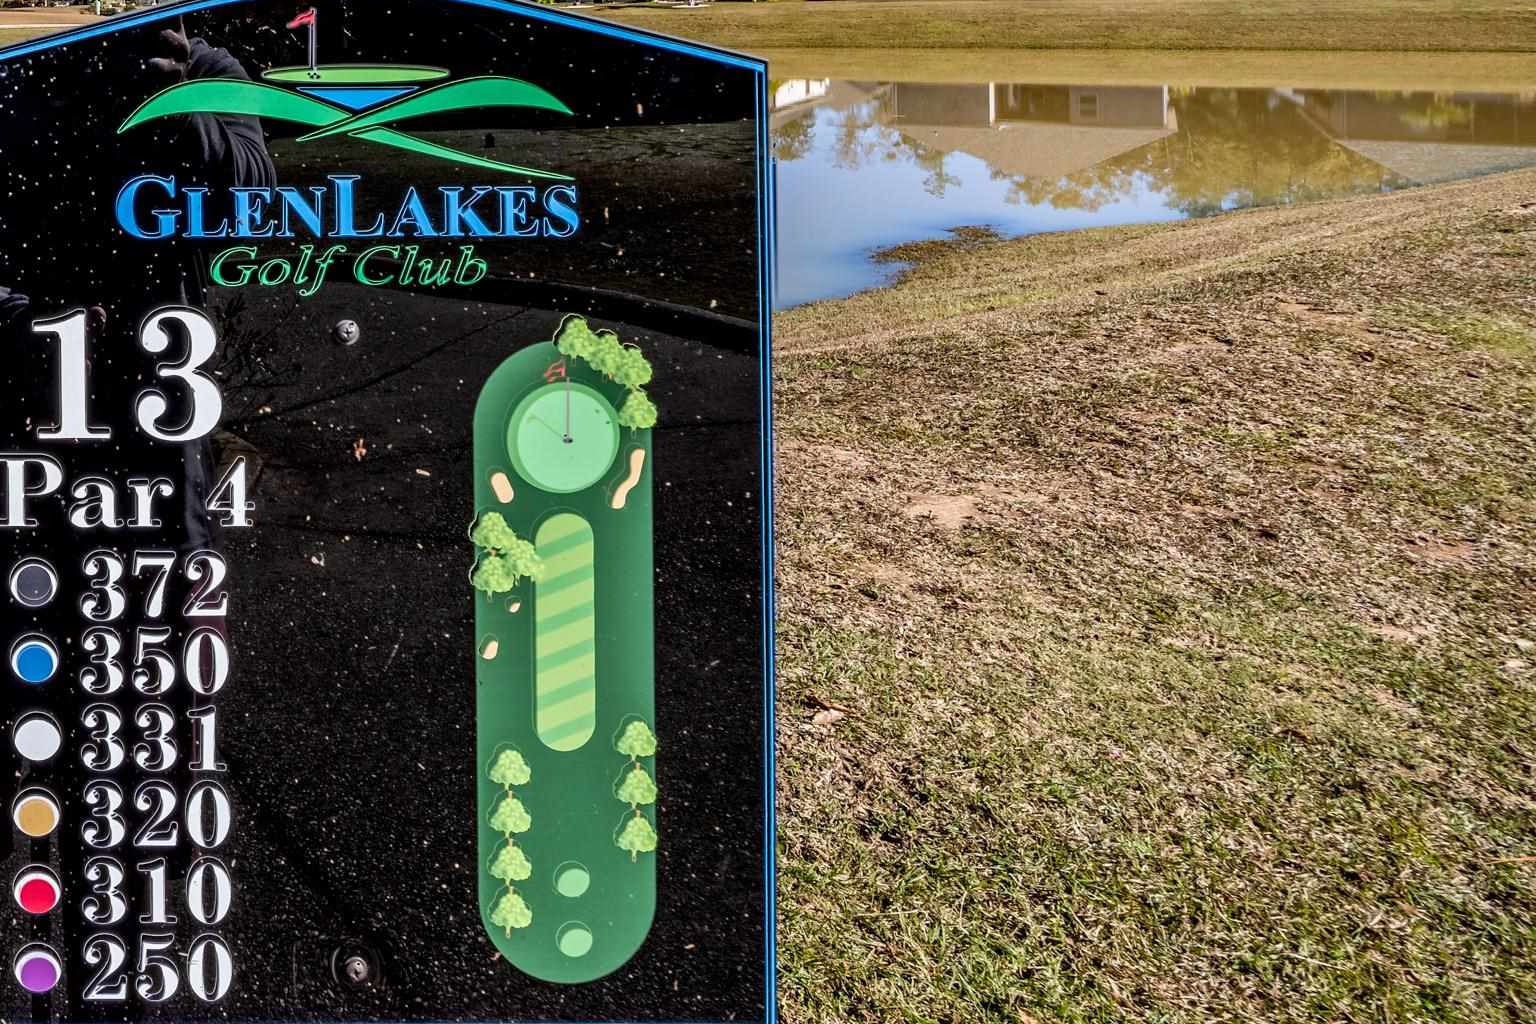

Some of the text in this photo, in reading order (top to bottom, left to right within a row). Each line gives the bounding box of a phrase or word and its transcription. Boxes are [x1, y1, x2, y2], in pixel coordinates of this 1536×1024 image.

[209, 244, 488, 297] Golf Club
[31, 305, 223, 442] 13
[206, 455, 255, 528] 4
[80, 550, 229, 621] 372
[80, 627, 230, 695] 350
[80, 704, 227, 772] 331
[81, 780, 231, 849] 320
[82, 856, 233, 925] 310
[84, 933, 234, 1002] 250
